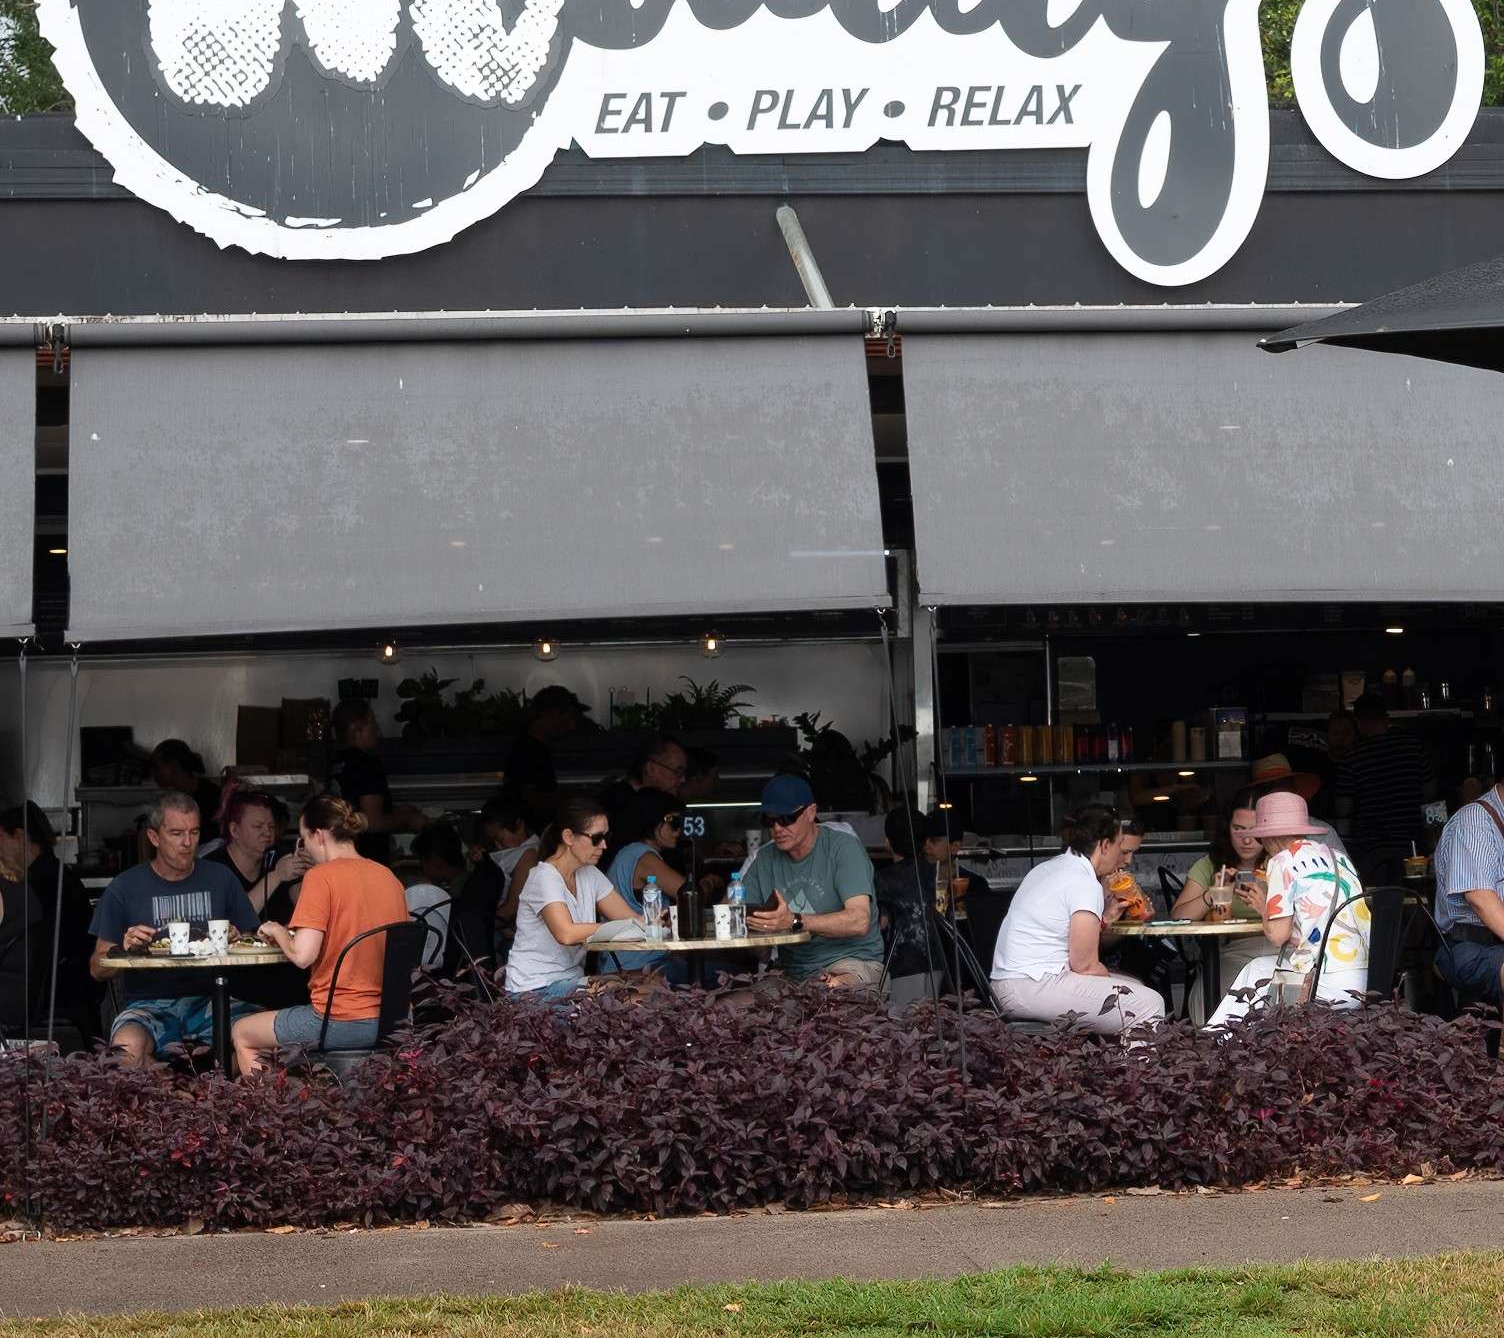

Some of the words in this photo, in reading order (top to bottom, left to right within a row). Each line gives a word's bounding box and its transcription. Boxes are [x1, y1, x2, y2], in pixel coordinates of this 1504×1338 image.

[594, 91, 687, 134] EAT
[746, 87, 870, 131] PLAY
[926, 84, 1083, 127] RELAX
[683, 816, 705, 836] 53
